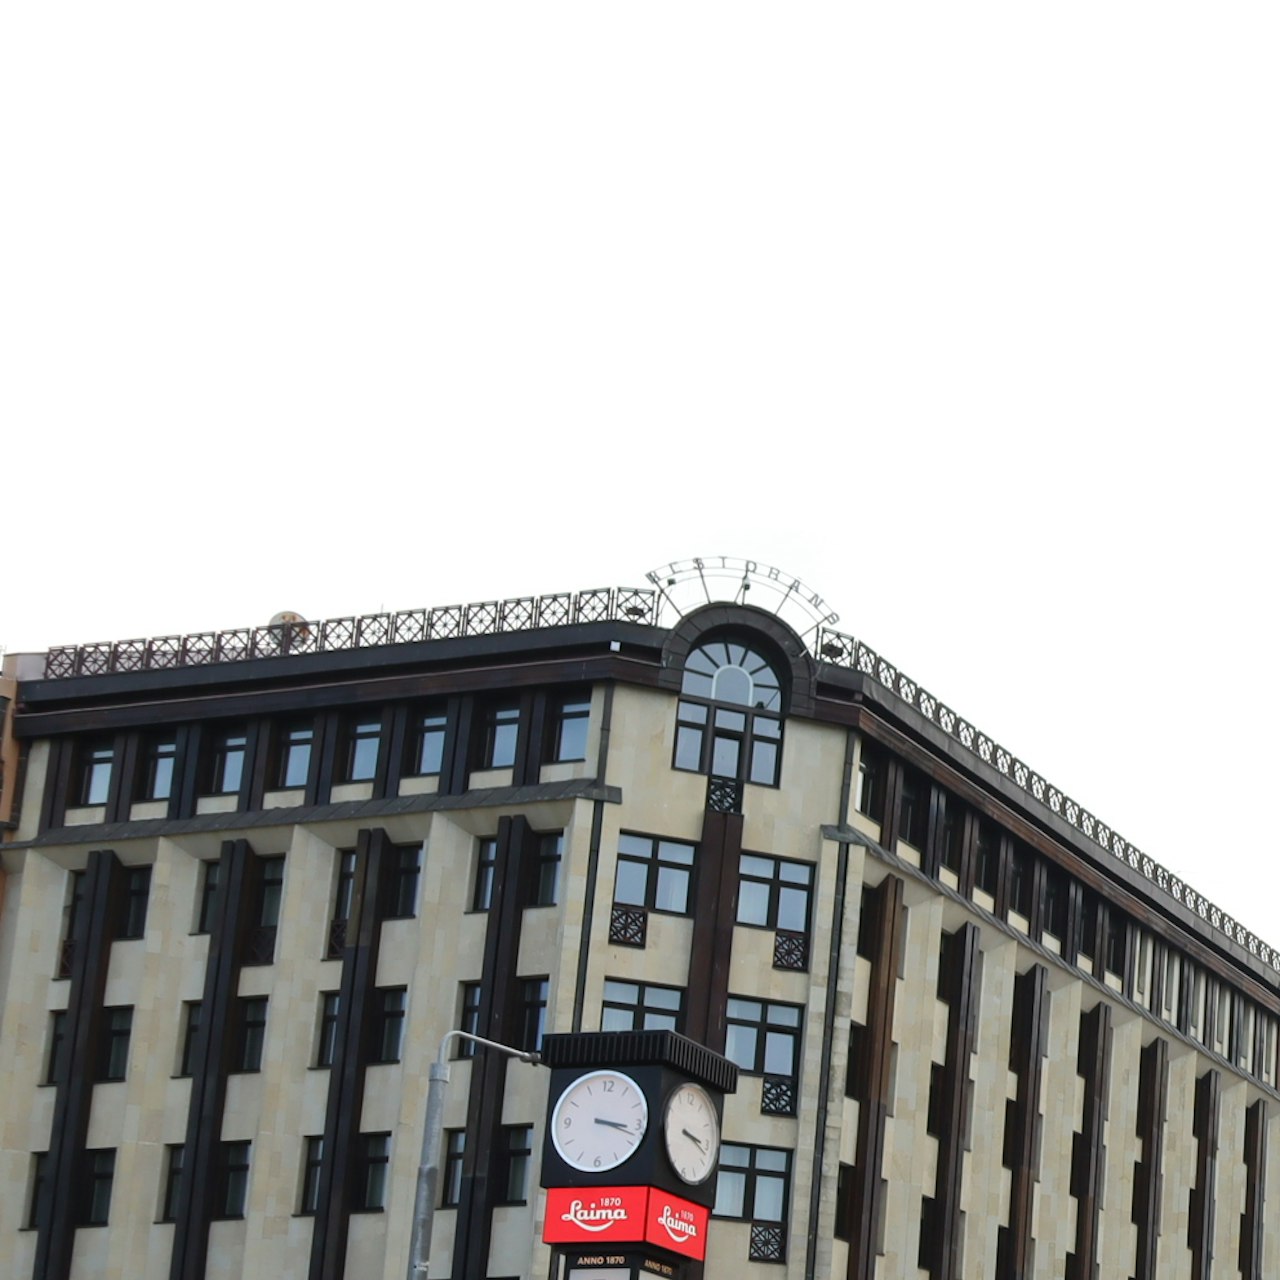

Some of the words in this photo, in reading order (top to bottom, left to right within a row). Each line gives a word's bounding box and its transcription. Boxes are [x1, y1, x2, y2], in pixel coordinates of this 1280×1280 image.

[602, 1080, 615, 1092] 12
[563, 1117, 572, 1129] 9
[634, 1119, 642, 1131] 3
[593, 1155, 602, 1168] 6
[600, 1198, 622, 1207] 1870
[561, 1200, 628, 1232] Laima
[657, 1205, 697, 1242] Laima
[577, 1256, 604, 1265] ANNO
[606, 1255, 625, 1264] 1870
